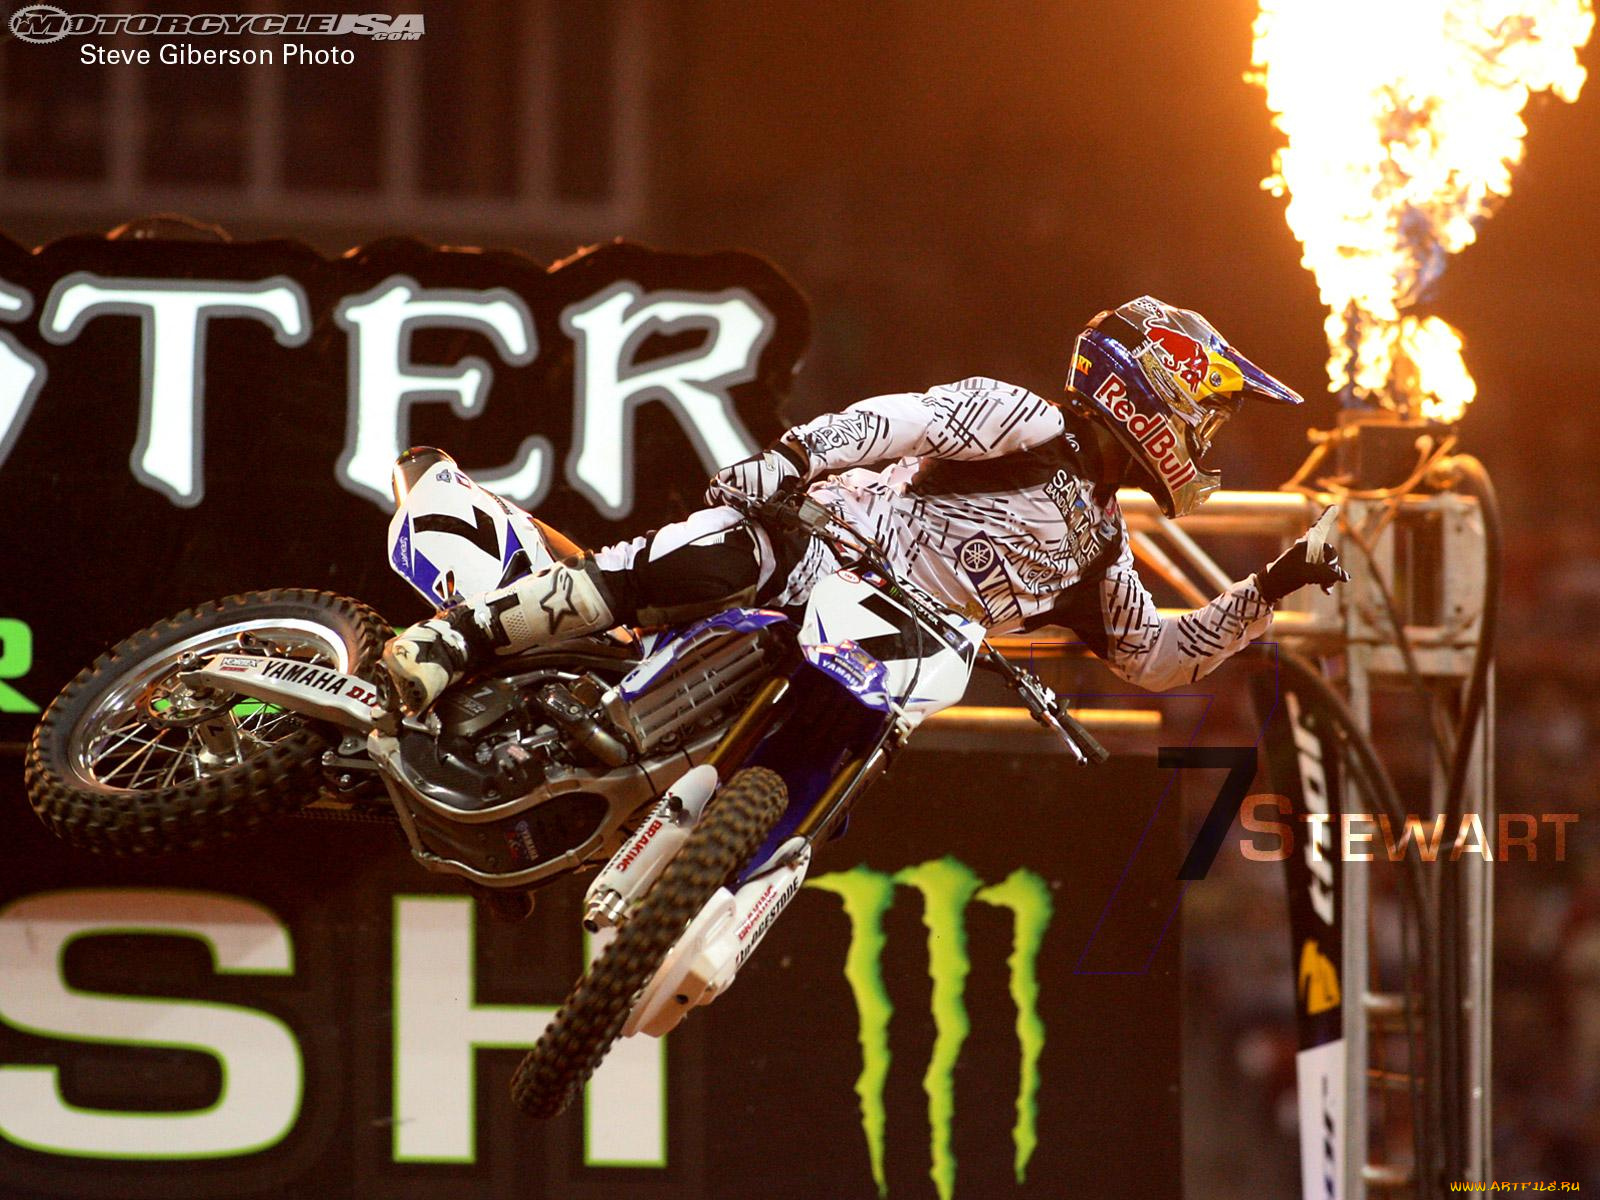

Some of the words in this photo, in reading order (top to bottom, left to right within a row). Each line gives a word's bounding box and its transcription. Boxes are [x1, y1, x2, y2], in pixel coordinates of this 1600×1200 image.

[0, 272, 774, 519] TER
[977, 564, 1021, 626] YAMA
[261, 661, 348, 695] YAMAHA
[822, 659, 861, 687] YAMAH
[616, 820, 662, 872] BRAKING
